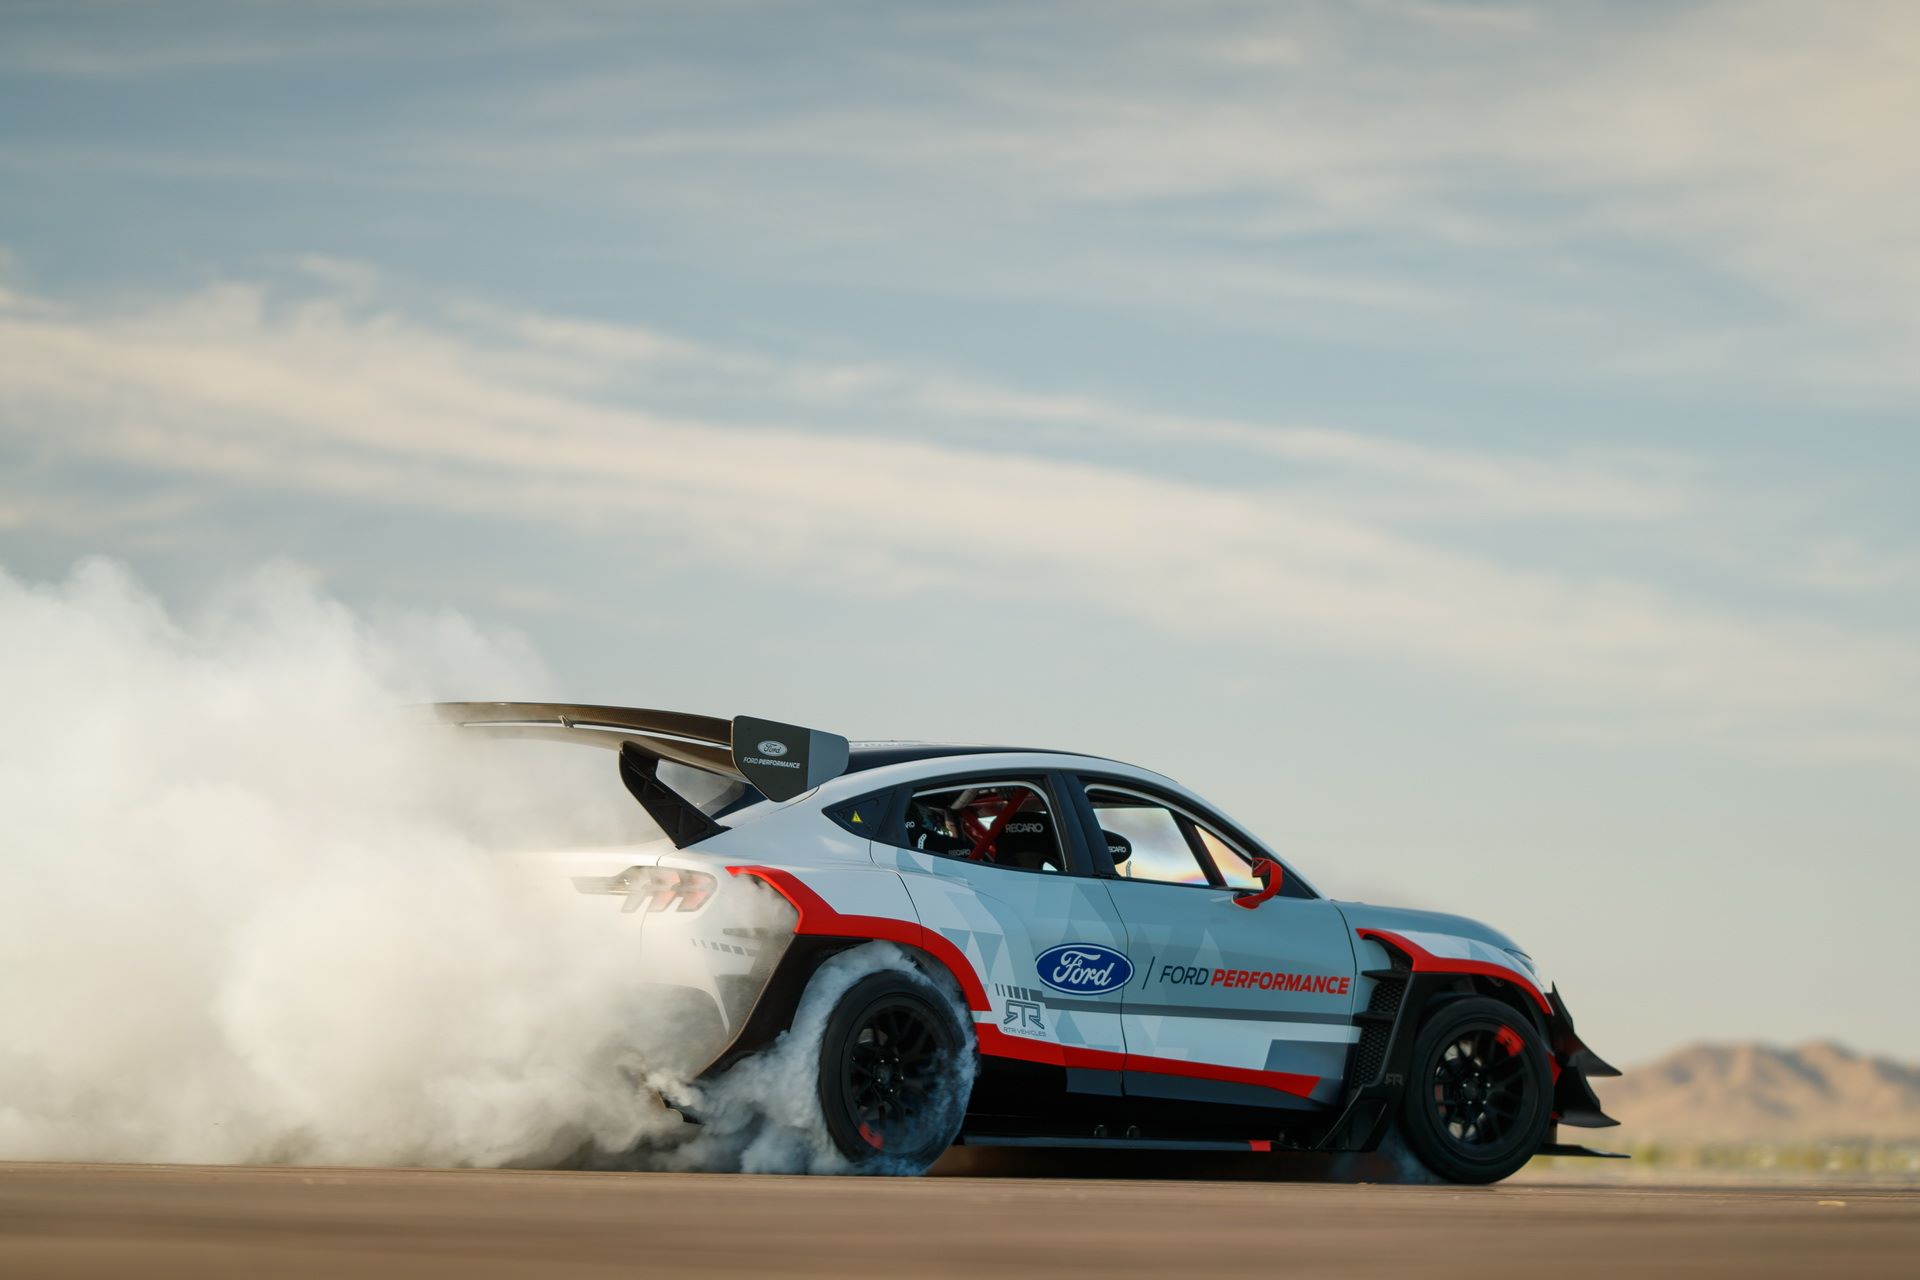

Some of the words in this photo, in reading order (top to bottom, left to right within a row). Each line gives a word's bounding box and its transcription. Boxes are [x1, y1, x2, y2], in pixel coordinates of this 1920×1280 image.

[763, 743, 782, 754] Ford
[743, 756, 759, 765] FORD
[759, 758, 801, 769] PERFORMANCE
[1005, 823, 1044, 833] RECARO
[1107, 845, 1127, 853] ECARO
[1052, 950, 1116, 986] Ford
[1159, 965, 1209, 986] FORD
[1210, 968, 1351, 995] PERFORMANCE
[1017, 1028, 1047, 1037] VEHICLES
